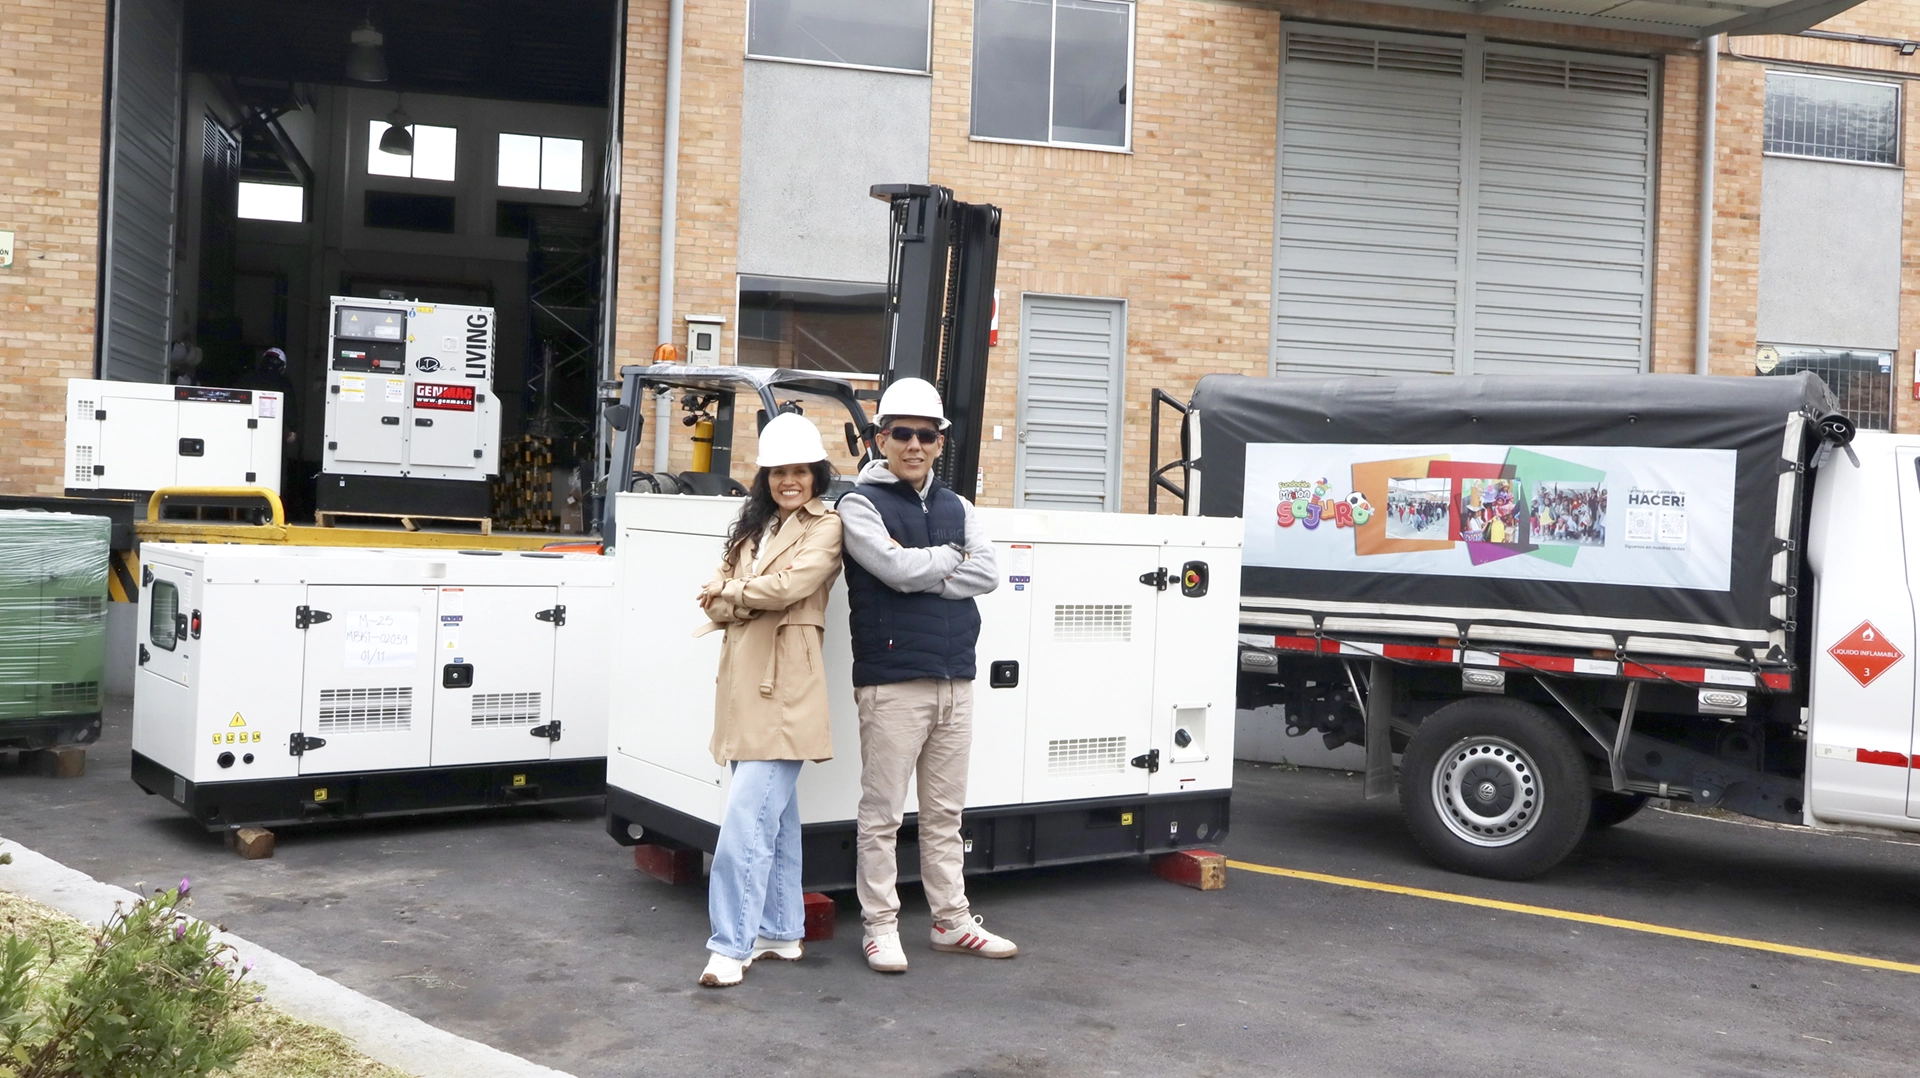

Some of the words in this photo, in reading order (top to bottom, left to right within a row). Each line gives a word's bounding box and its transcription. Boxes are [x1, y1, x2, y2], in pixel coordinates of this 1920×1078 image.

[465, 314, 488, 379] LIVING
[416, 385, 472, 400] GENMAC
[416, 397, 472, 406] www.genmac.it
[1628, 494, 1685, 507] HACER!
[1860, 650, 1898, 658] INFLAMABLE
[1863, 667, 1870, 677] 3
